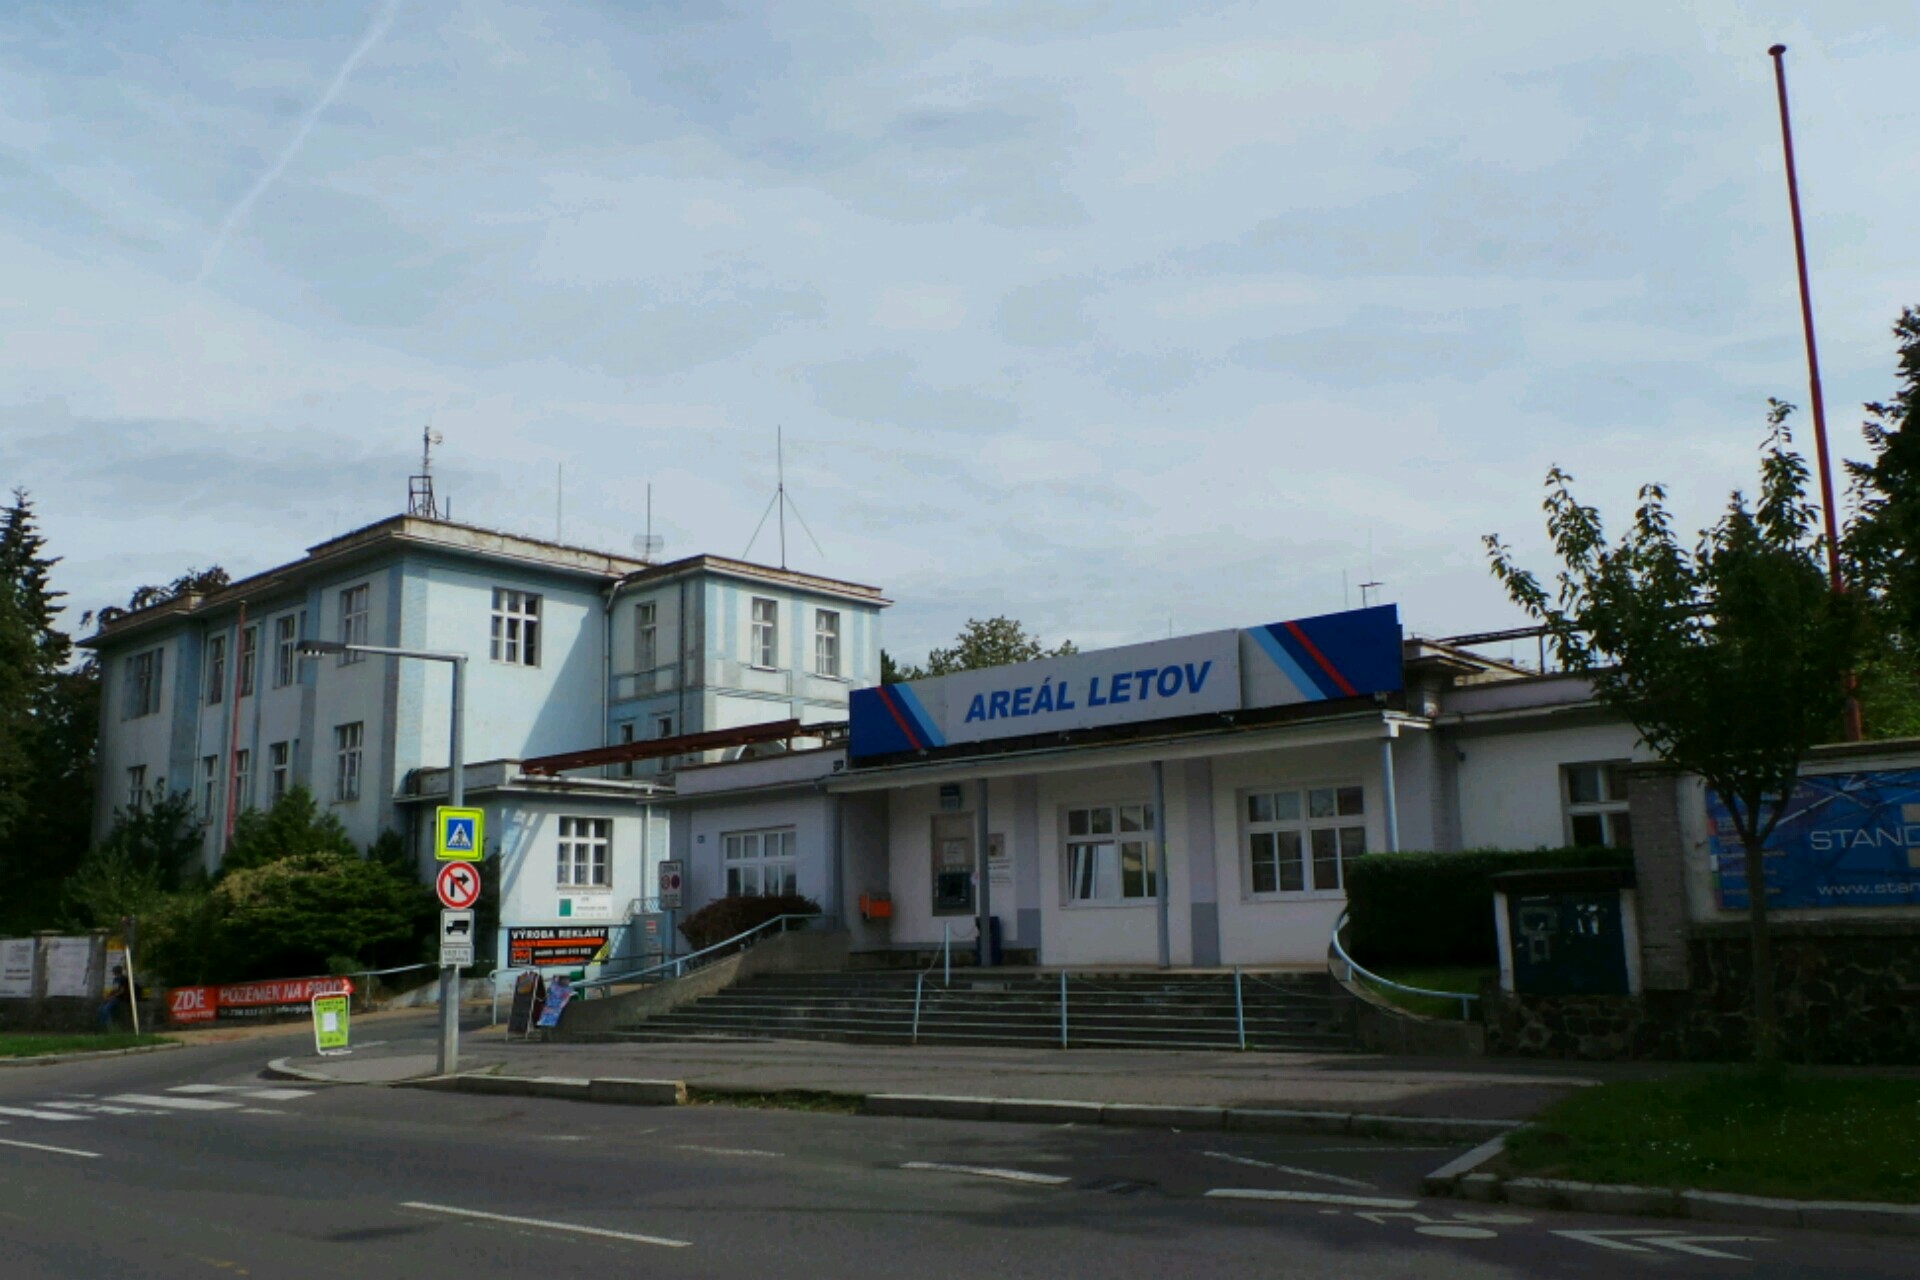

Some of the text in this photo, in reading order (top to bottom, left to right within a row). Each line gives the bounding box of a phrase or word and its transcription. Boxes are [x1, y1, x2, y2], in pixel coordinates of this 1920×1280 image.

[964, 661, 1212, 723] AREÁL LETOV
[511, 928, 606, 939] VÝROBA REKLAMY
[172, 988, 206, 1011] ZDE
[283, 982, 303, 1000] NA
